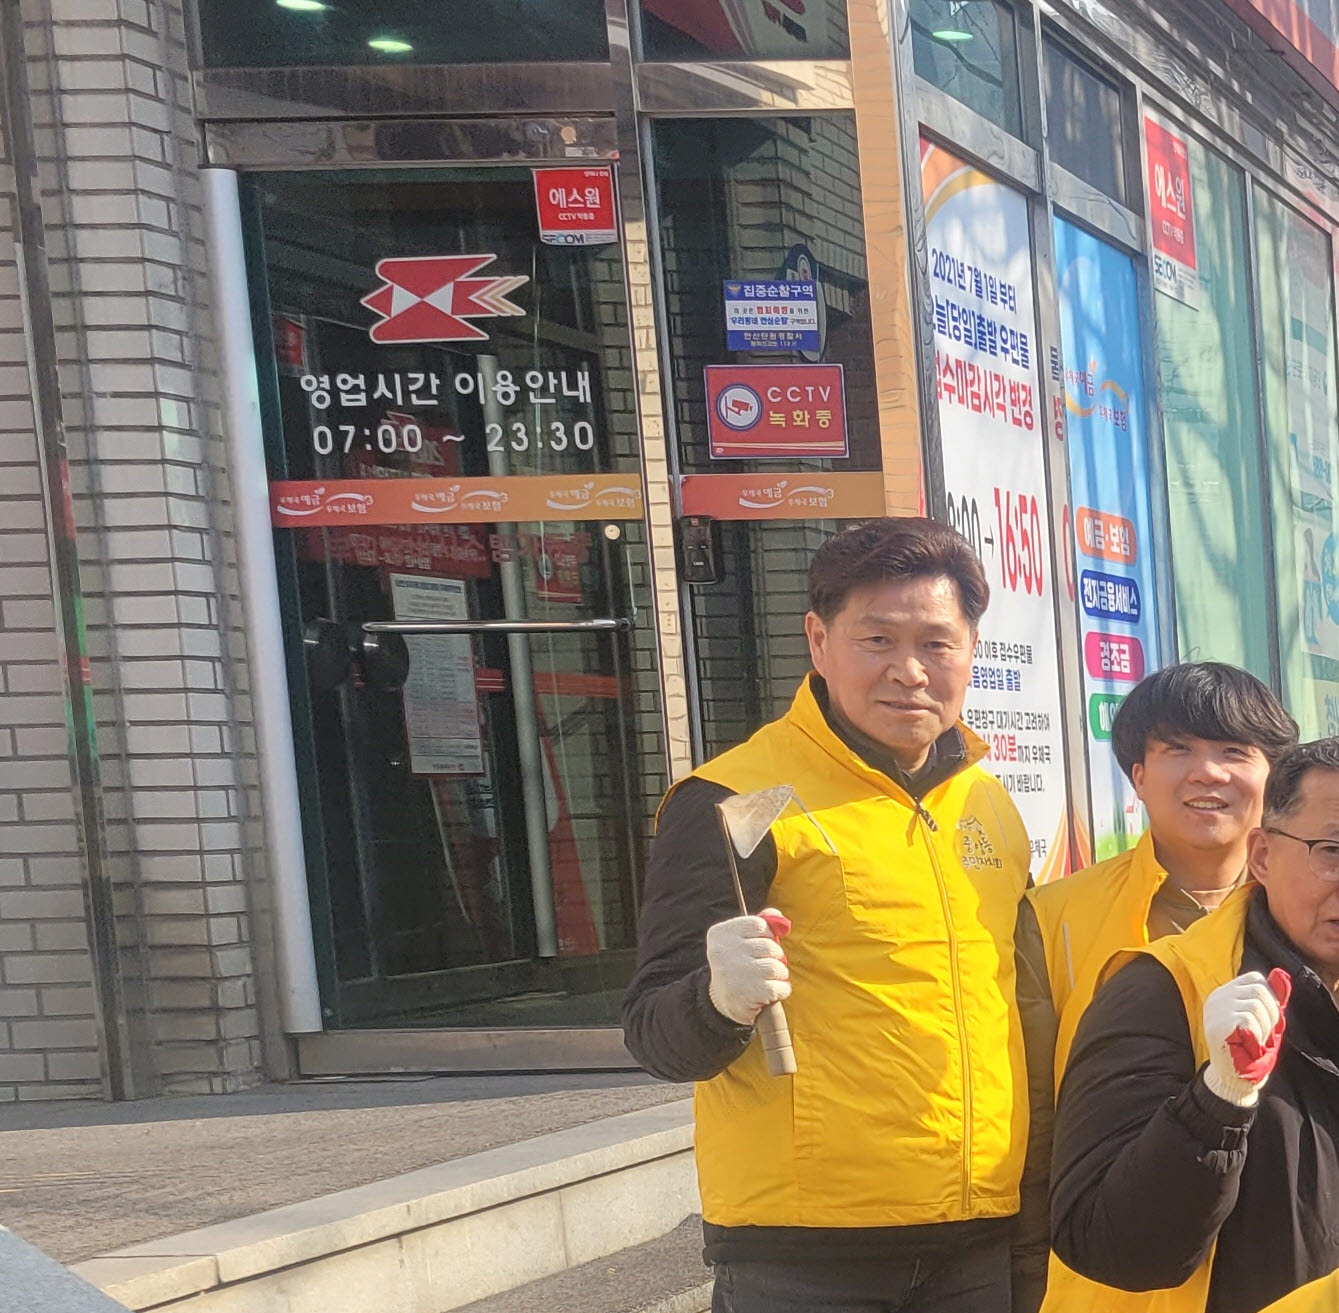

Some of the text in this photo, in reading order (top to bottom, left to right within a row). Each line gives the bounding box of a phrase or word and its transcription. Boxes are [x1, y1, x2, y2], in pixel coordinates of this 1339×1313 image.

[549, 187, 601, 208] 에스원
[1154, 163, 1186, 220] 에스원
[932, 248, 1017, 314] 2021년 7월 1일 부터
[1155, 255, 1178, 284] SECOM
[743, 285, 814, 298] 집중순찰구역
[931, 295, 1030, 370] 늘[당일]출발 우편물
[300, 370, 592, 409] 영업시간 이용안내
[767, 386, 831, 402] CCTV
[769, 410, 832, 428] 녹화중
[1009, 379, 1034, 431] 변경
[313, 424, 422, 455] 07:00
[485, 421, 594, 452] 23:30
[994, 487, 1043, 598] 16:50
[1084, 577, 1138, 616] 전자금융서비스
[985, 640, 998, 661] 이후
[1000, 642, 1033, 665] 접수우편물
[1100, 641, 1131, 674] 경조금
[968, 665, 1021, 691] 음영업일 출발
[967, 709, 1051, 731] 우편창구 대기시간 고려하여
[1032, 745, 1051, 764] 우체국
[1017, 774, 1045, 793] 바랍니다.
